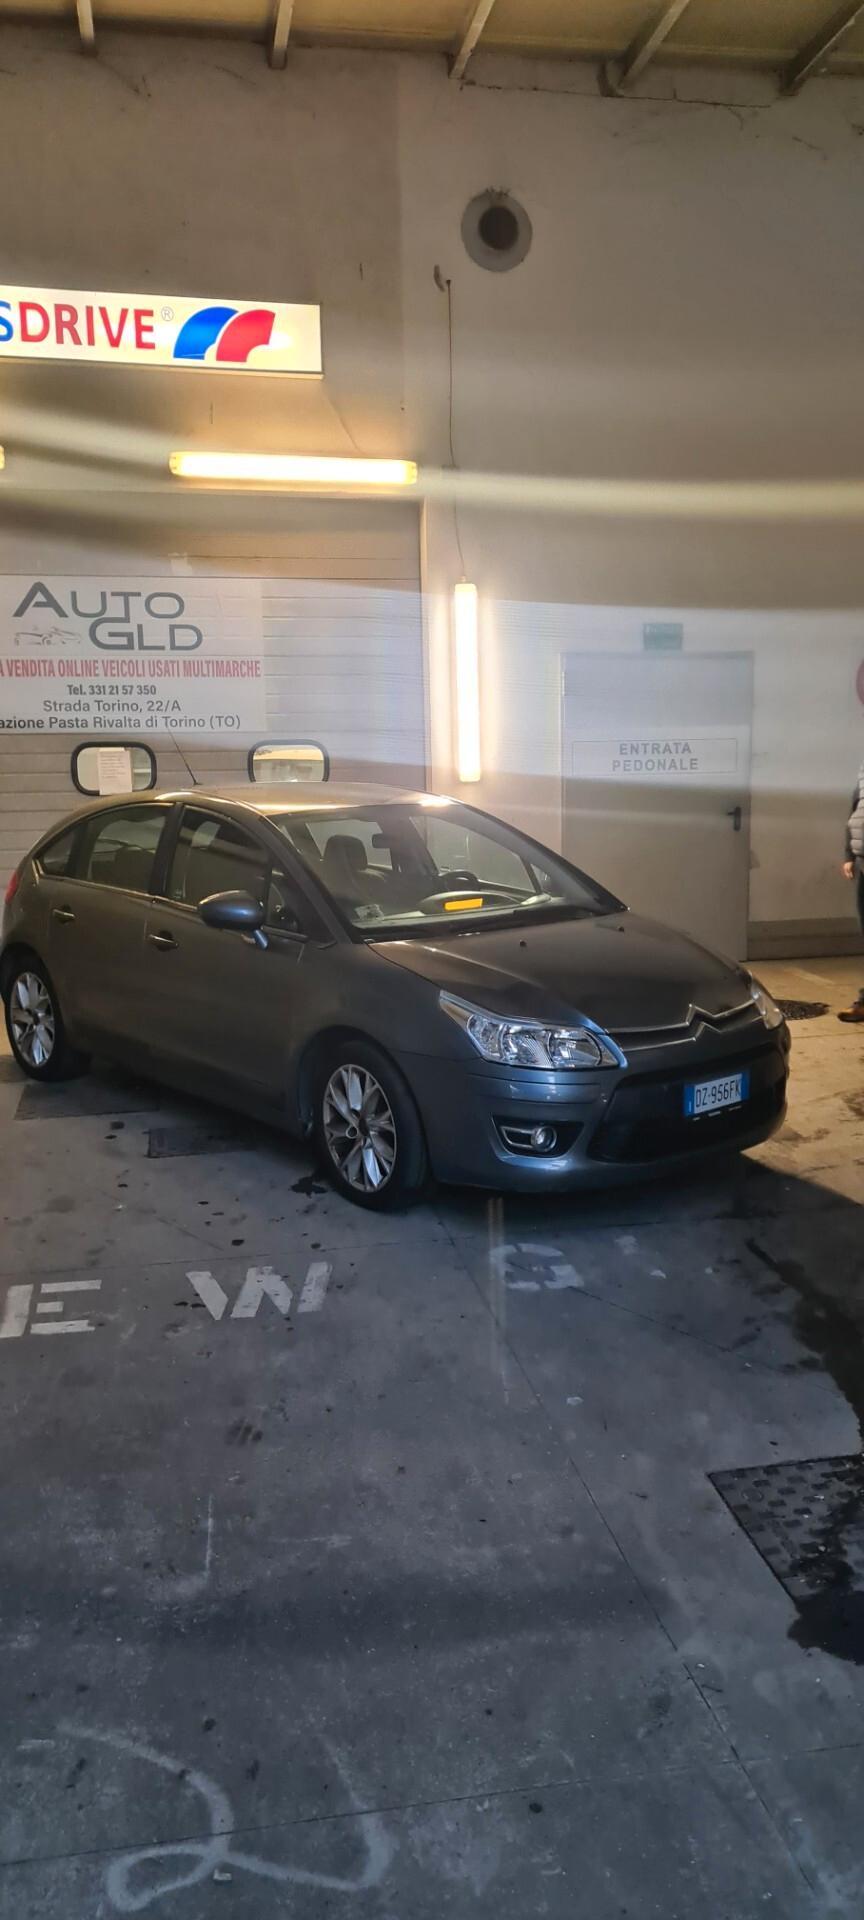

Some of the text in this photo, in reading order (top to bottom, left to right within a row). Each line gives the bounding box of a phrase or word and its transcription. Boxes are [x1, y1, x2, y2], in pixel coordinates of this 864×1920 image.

[89, 616, 203, 651] GLD
[6, 659, 55, 678] VENDITA
[58, 659, 99, 677] ONLINE
[102, 659, 146, 678] VEICOLI
[149, 659, 181, 677] USATI
[183, 659, 261, 677] MULTIMARCHE
[67, 684, 86, 696] Tel.
[121, 685, 134, 696] 57
[137, 684, 157, 696] 350
[43, 699, 181, 713] Strada Torino, 22/A
[49, 717, 89, 729] Pasta
[93, 716, 141, 728] Rivalta
[145, 716, 158, 728] di
[163, 715, 205, 728] Torino
[209, 715, 241, 729] (TO)
[618, 741, 692, 756] ENTRATA
[611, 757, 699, 772] PEDONALE
